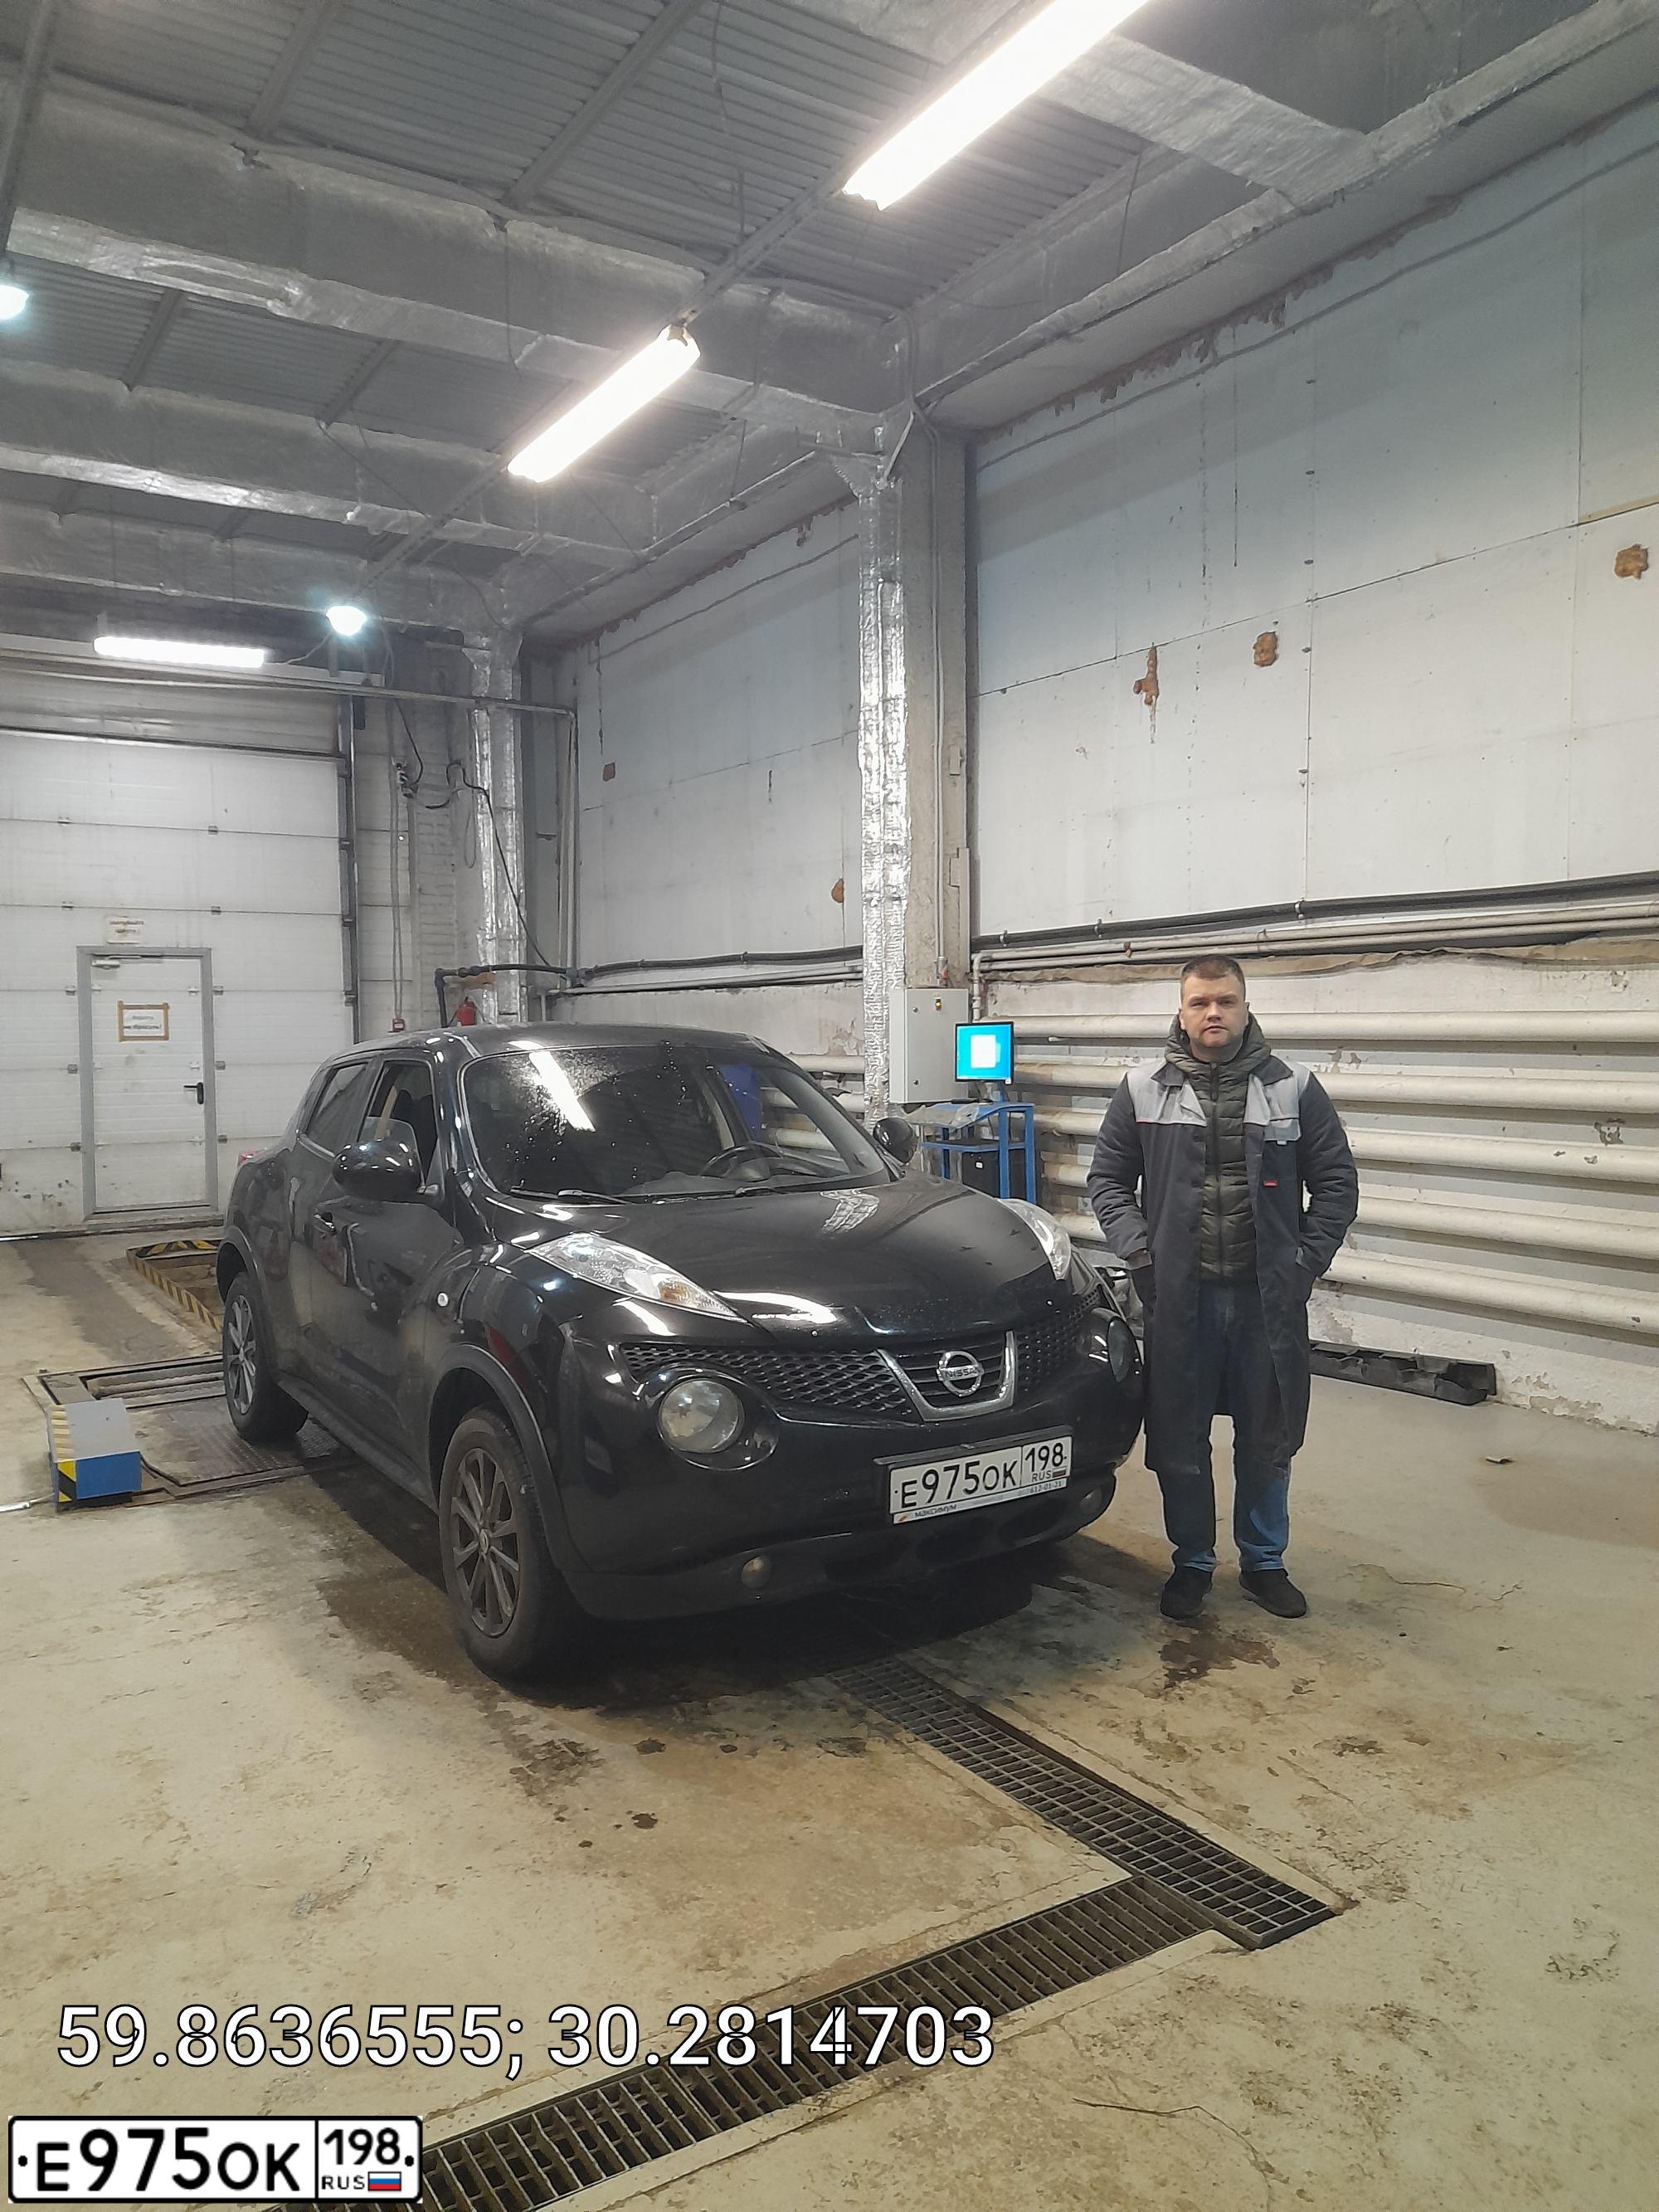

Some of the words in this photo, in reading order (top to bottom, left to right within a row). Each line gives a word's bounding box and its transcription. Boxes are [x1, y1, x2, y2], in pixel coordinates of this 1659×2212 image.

[900, 1459, 1019, 1508] Е975ОК
[1024, 1442, 1063, 1473] 198
[1031, 1471, 1052, 1483] RUS
